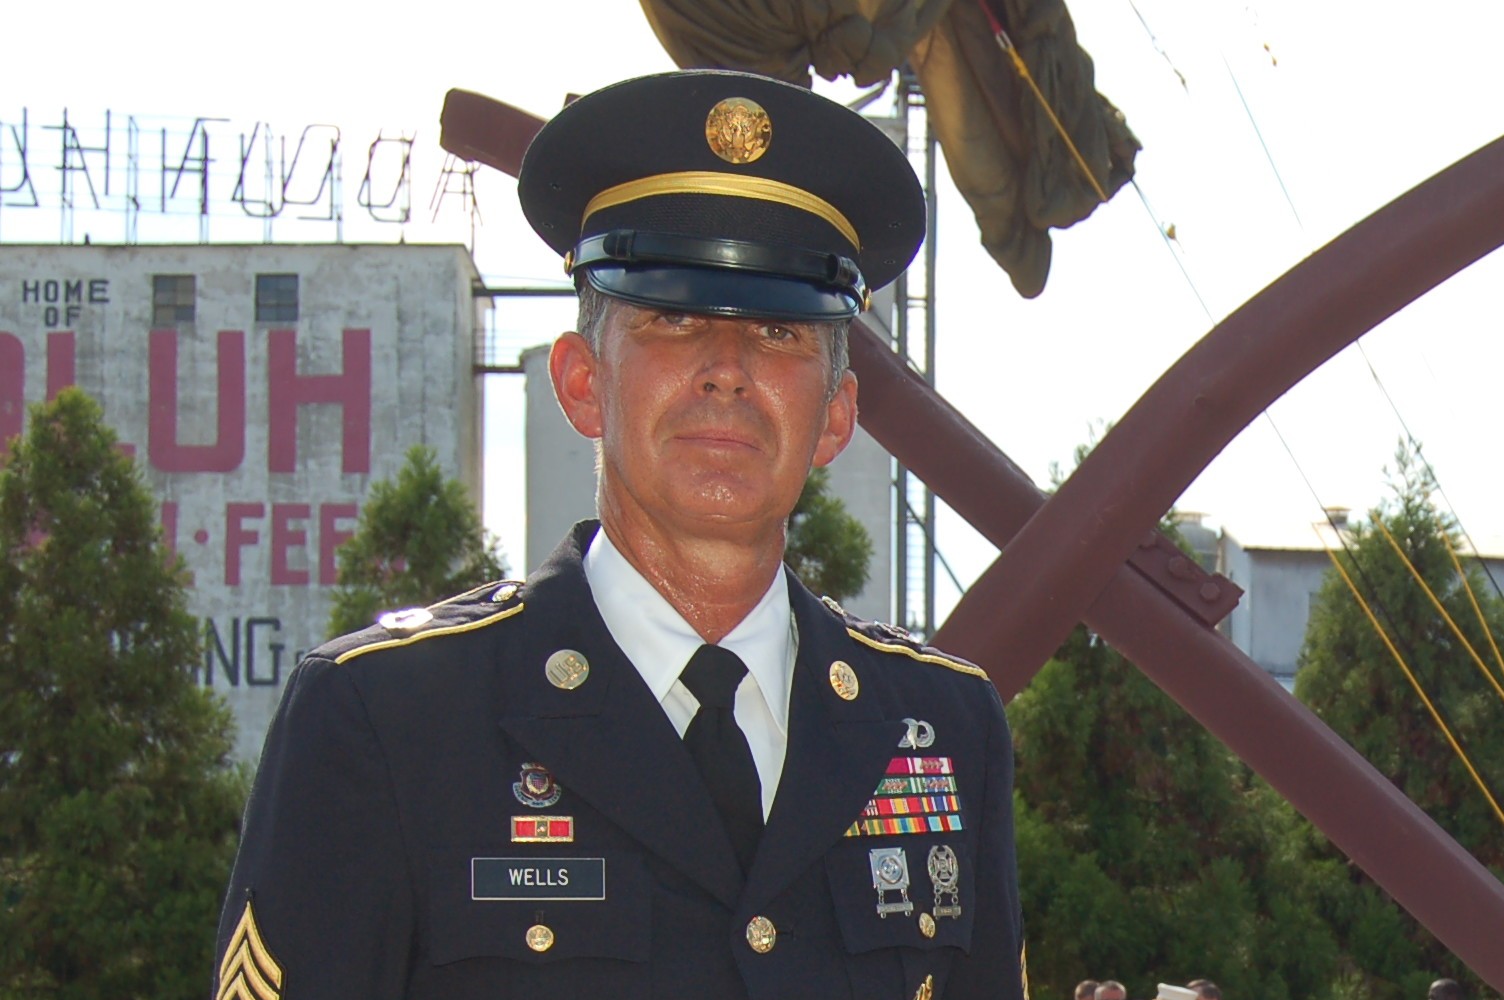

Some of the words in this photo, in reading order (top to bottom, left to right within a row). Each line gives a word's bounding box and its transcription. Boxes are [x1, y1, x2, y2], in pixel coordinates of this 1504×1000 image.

[22, 280, 110, 302] HOME
[44, 306, 80, 327] OF
[508, 868, 569, 886] WELLS
